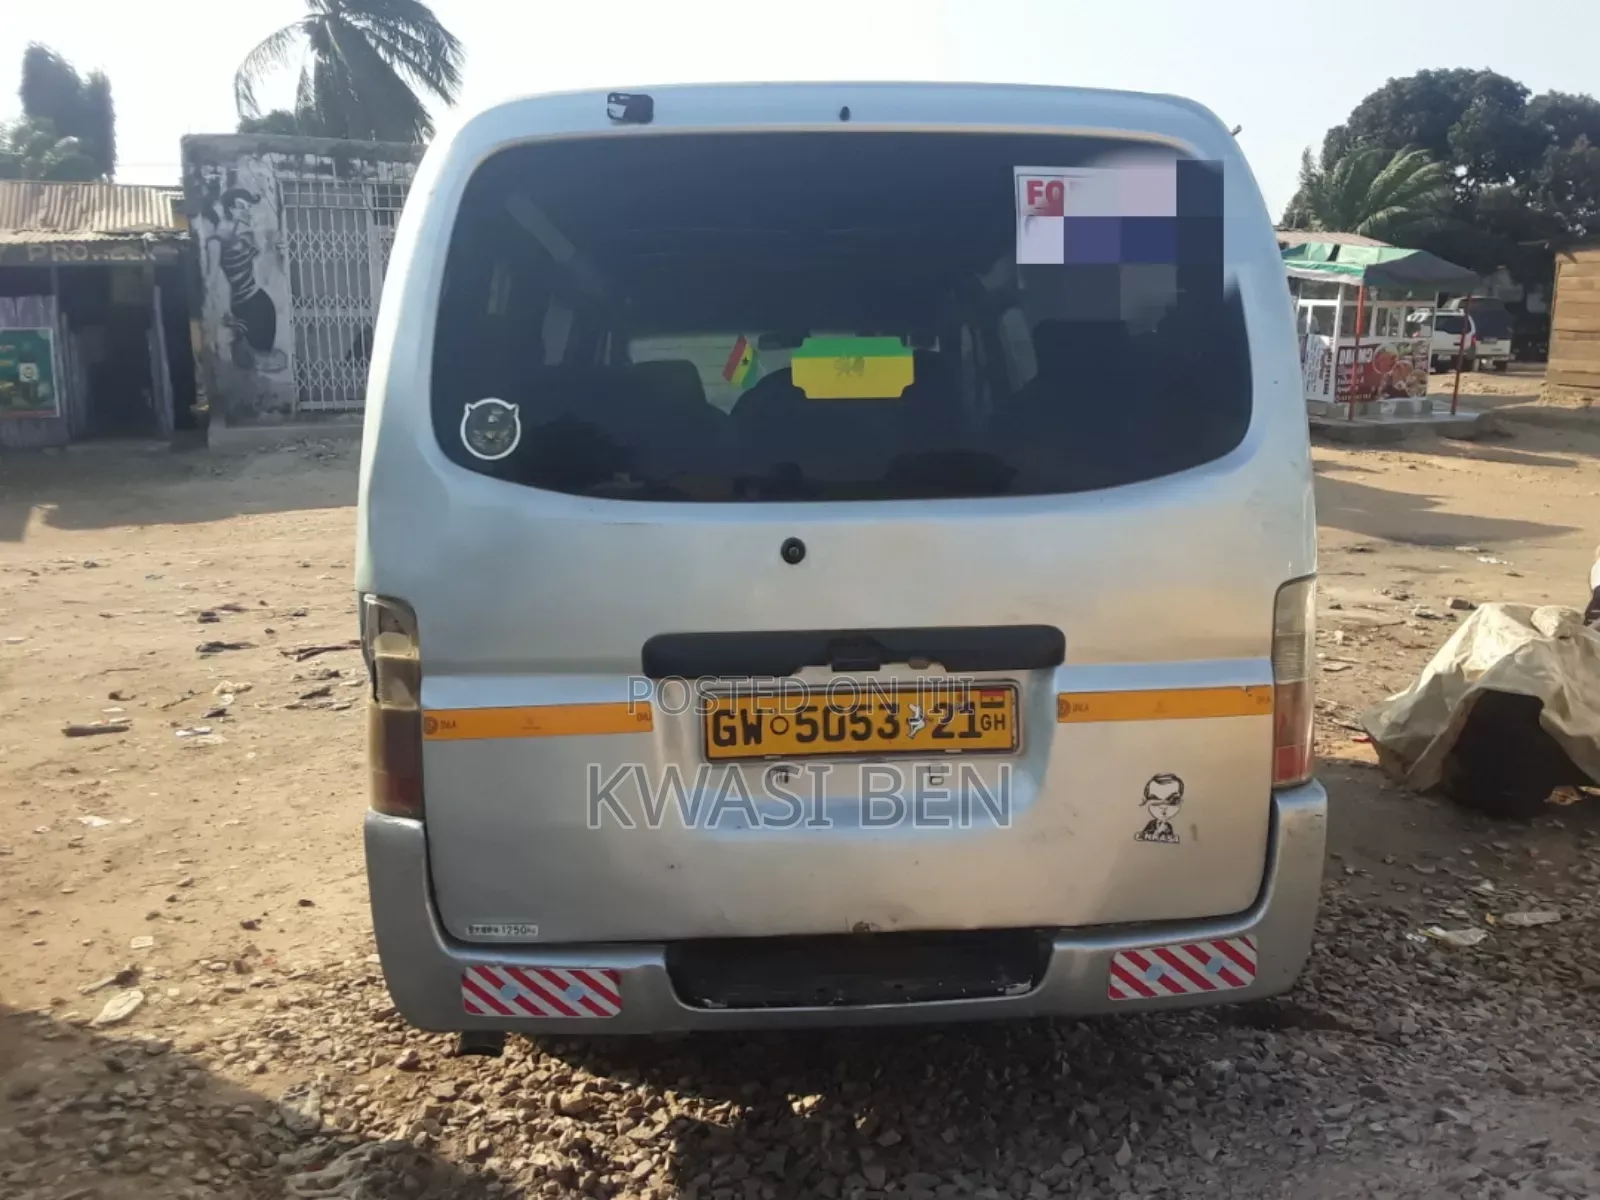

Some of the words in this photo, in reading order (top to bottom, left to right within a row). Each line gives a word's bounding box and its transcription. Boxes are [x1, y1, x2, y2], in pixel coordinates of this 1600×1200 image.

[713, 708, 762, 747] GW
[795, 702, 900, 742] 5053
[931, 702, 983, 739] 21
[980, 713, 1006, 731] GH
